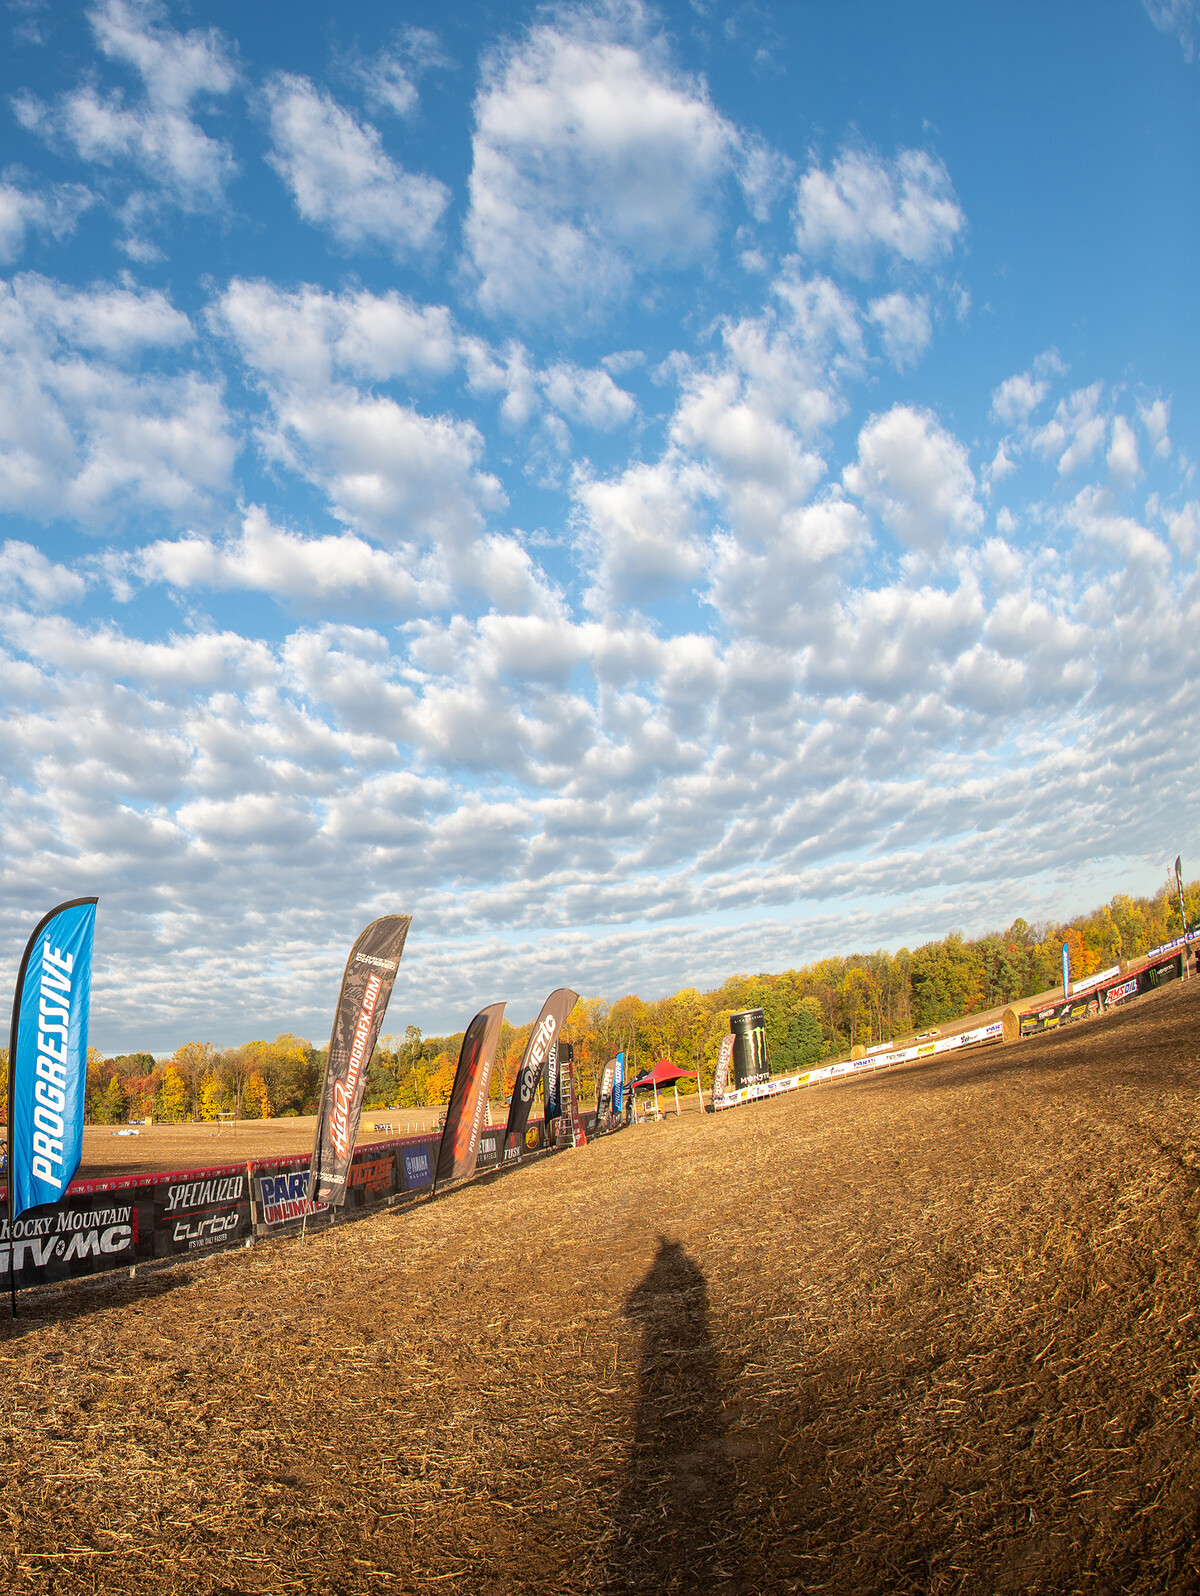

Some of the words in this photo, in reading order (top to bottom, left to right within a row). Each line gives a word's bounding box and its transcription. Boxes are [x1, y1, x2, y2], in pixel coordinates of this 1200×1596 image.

[1106, 981, 1137, 1004] AMSOIL
[344, 975, 381, 1100] MOTOGRAFX.COM
[33, 941, 75, 1189] PROGRESSIVE
[521, 1014, 556, 1102] COMETIC
[715, 1041, 729, 1096] HOLESHOT
[740, 1072, 769, 1085] MONST
[468, 1090, 485, 1153] POWERSPORTS
[481, 1062, 490, 1087] TIRES
[411, 1154, 429, 1173] YAMAHA
[504, 1146, 521, 1160] TUSK
[347, 1156, 396, 1187] MOOSE
[409, 1171, 428, 1180] RACING
[164, 1176, 244, 1212] SPECIALIZED
[260, 1172, 311, 1206] PART
[55, 1206, 132, 1233] MOUNTAIN
[173, 1211, 239, 1242] turbo
